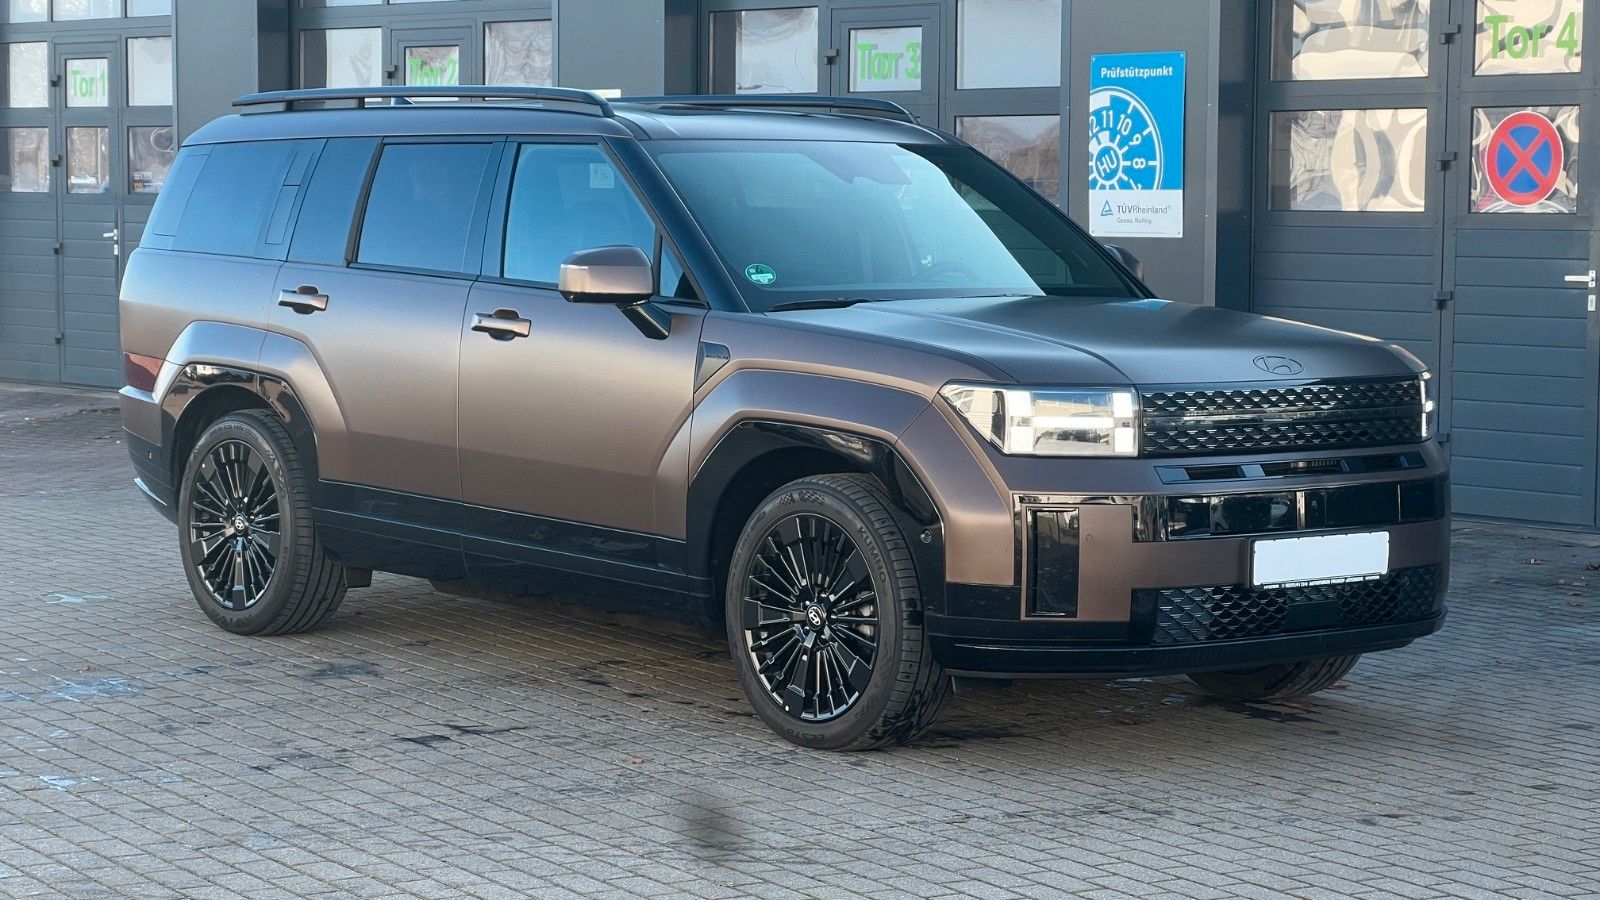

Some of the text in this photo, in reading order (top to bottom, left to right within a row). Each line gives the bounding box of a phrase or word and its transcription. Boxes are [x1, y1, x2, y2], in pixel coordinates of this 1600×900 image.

[1484, 11, 1579, 59] Tor 4
[857, 41, 920, 80] Tor 3
[1100, 65, 1173, 79] Prüfstützpunkt
[71, 68, 107, 97] Tor 1
[1101, 109, 1114, 129] 11
[1116, 113, 1132, 136] 10
[1128, 133, 1142, 146] 9
[1097, 149, 1118, 178] HU
[1132, 157, 1146, 170] 8
